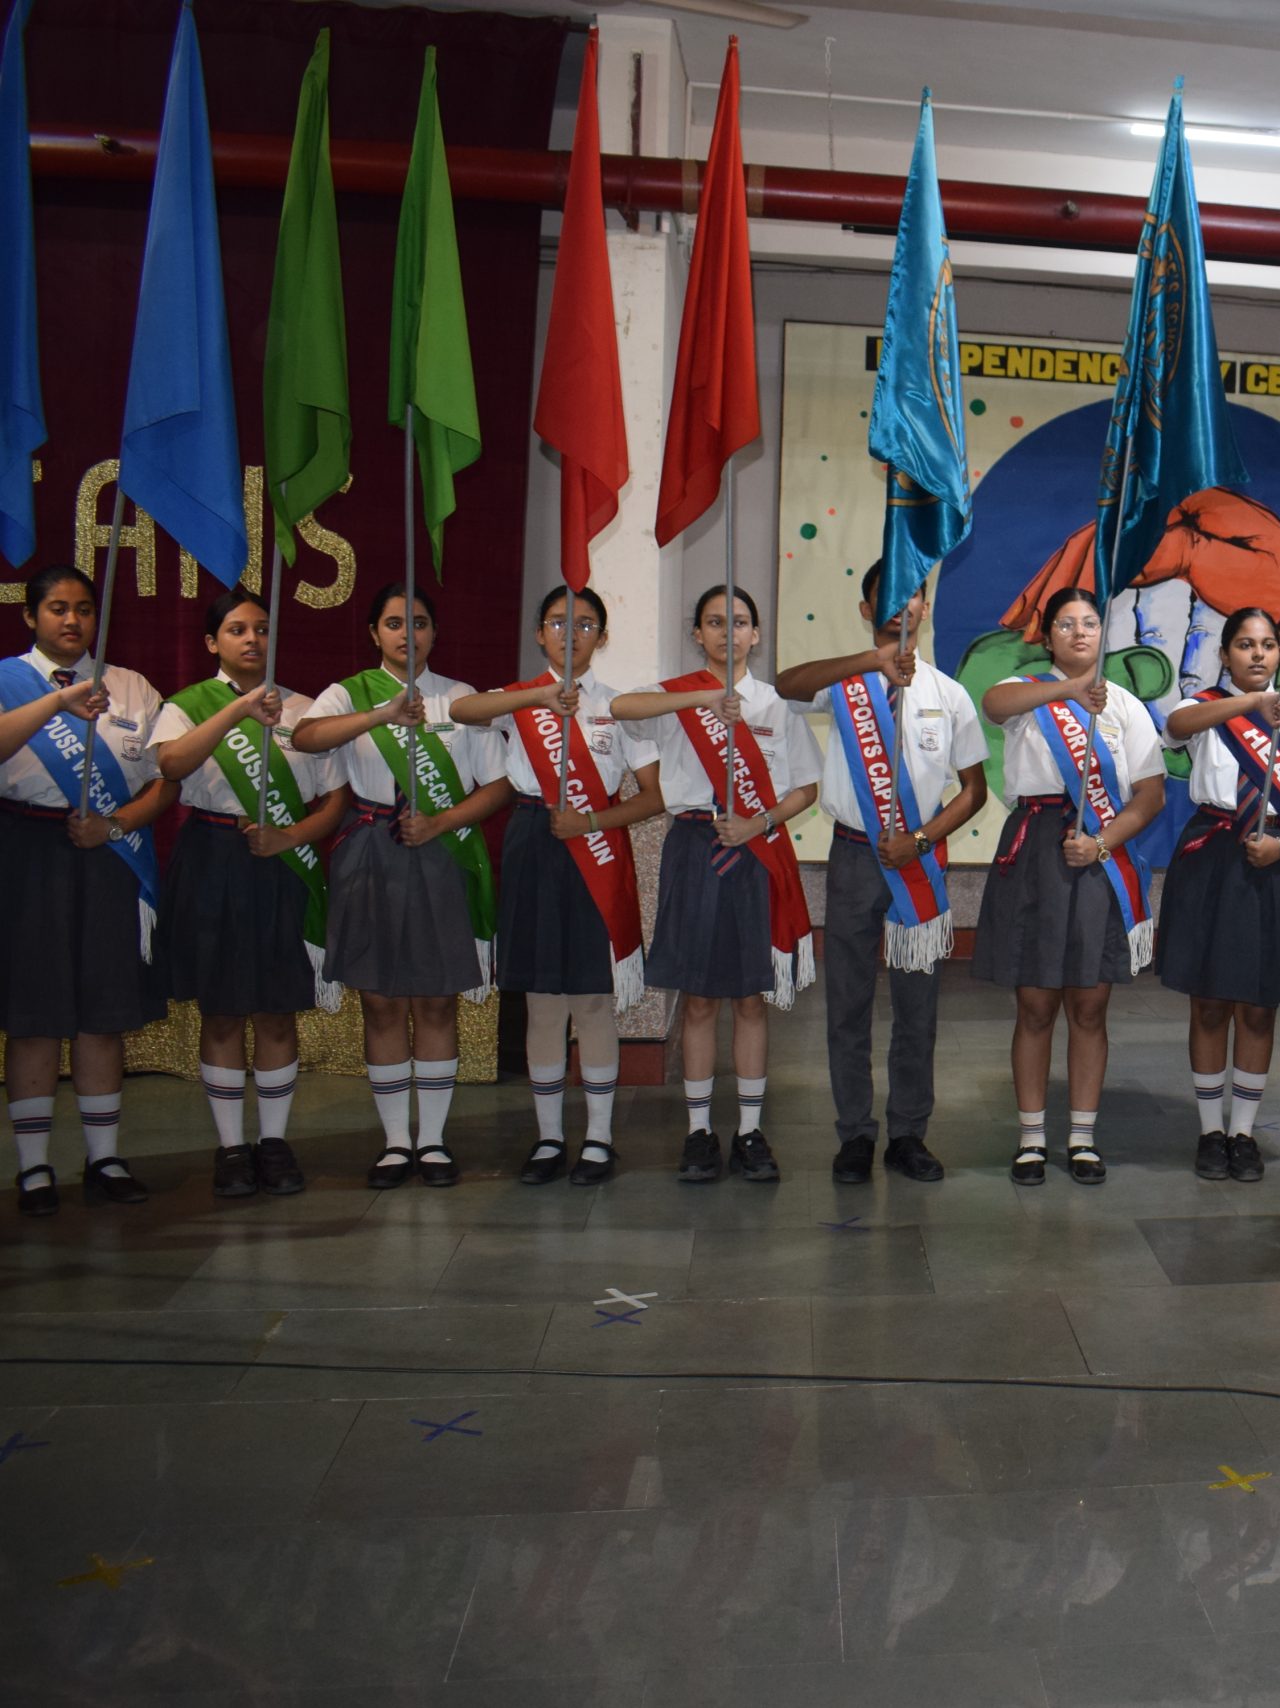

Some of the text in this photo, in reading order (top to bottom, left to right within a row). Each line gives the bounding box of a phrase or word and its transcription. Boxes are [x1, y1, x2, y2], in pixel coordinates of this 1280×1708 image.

[44, 715, 86, 760] OUSE
[695, 706, 729, 745] OUSE
[846, 682, 883, 759] SPORTS
